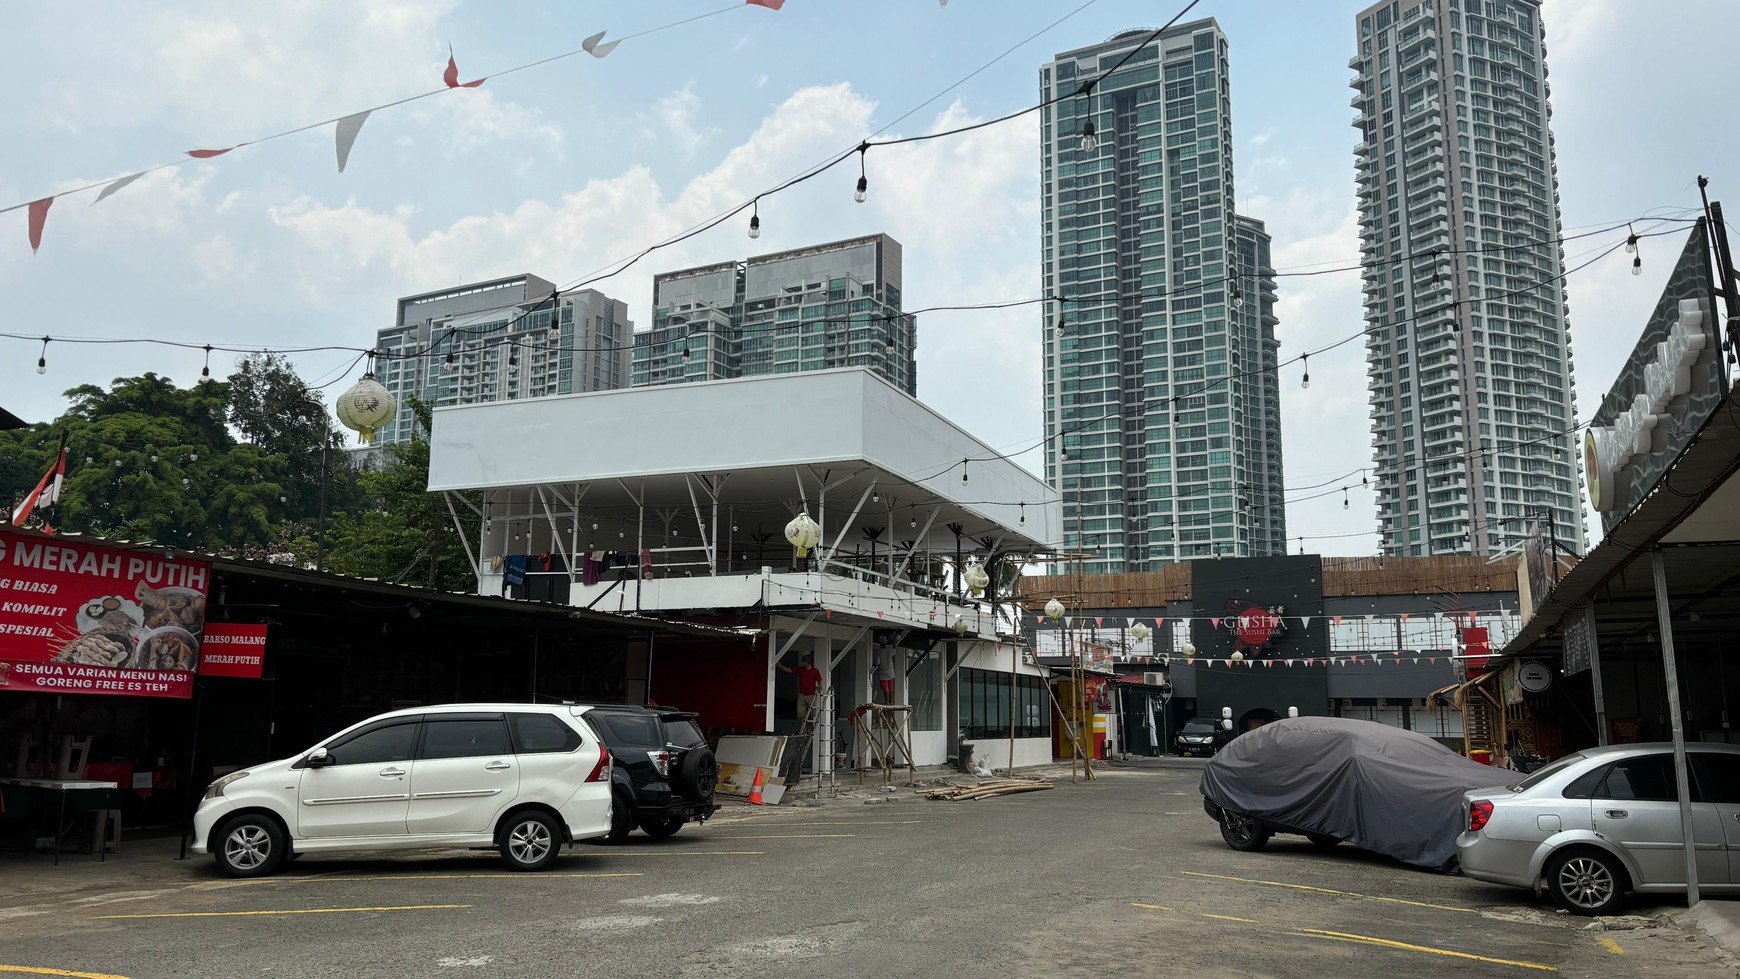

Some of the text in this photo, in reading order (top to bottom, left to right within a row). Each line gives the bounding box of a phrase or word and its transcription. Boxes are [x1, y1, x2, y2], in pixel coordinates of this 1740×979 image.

[13, 541, 122, 579] MERAH
[127, 558, 206, 589] PUTIH
[12, 579, 58, 594] BIASA
[1, 601, 68, 617] KOMPLIT
[0, 623, 54, 637] SPESIAL
[203, 635, 266, 645] BAKSO MALANG
[204, 654, 260, 665] MERAH PUTIH
[15, 663, 188, 682] SEMUA VARIAN MENU NASI
[36, 677, 168, 692] GORENG FREE ES TEH
